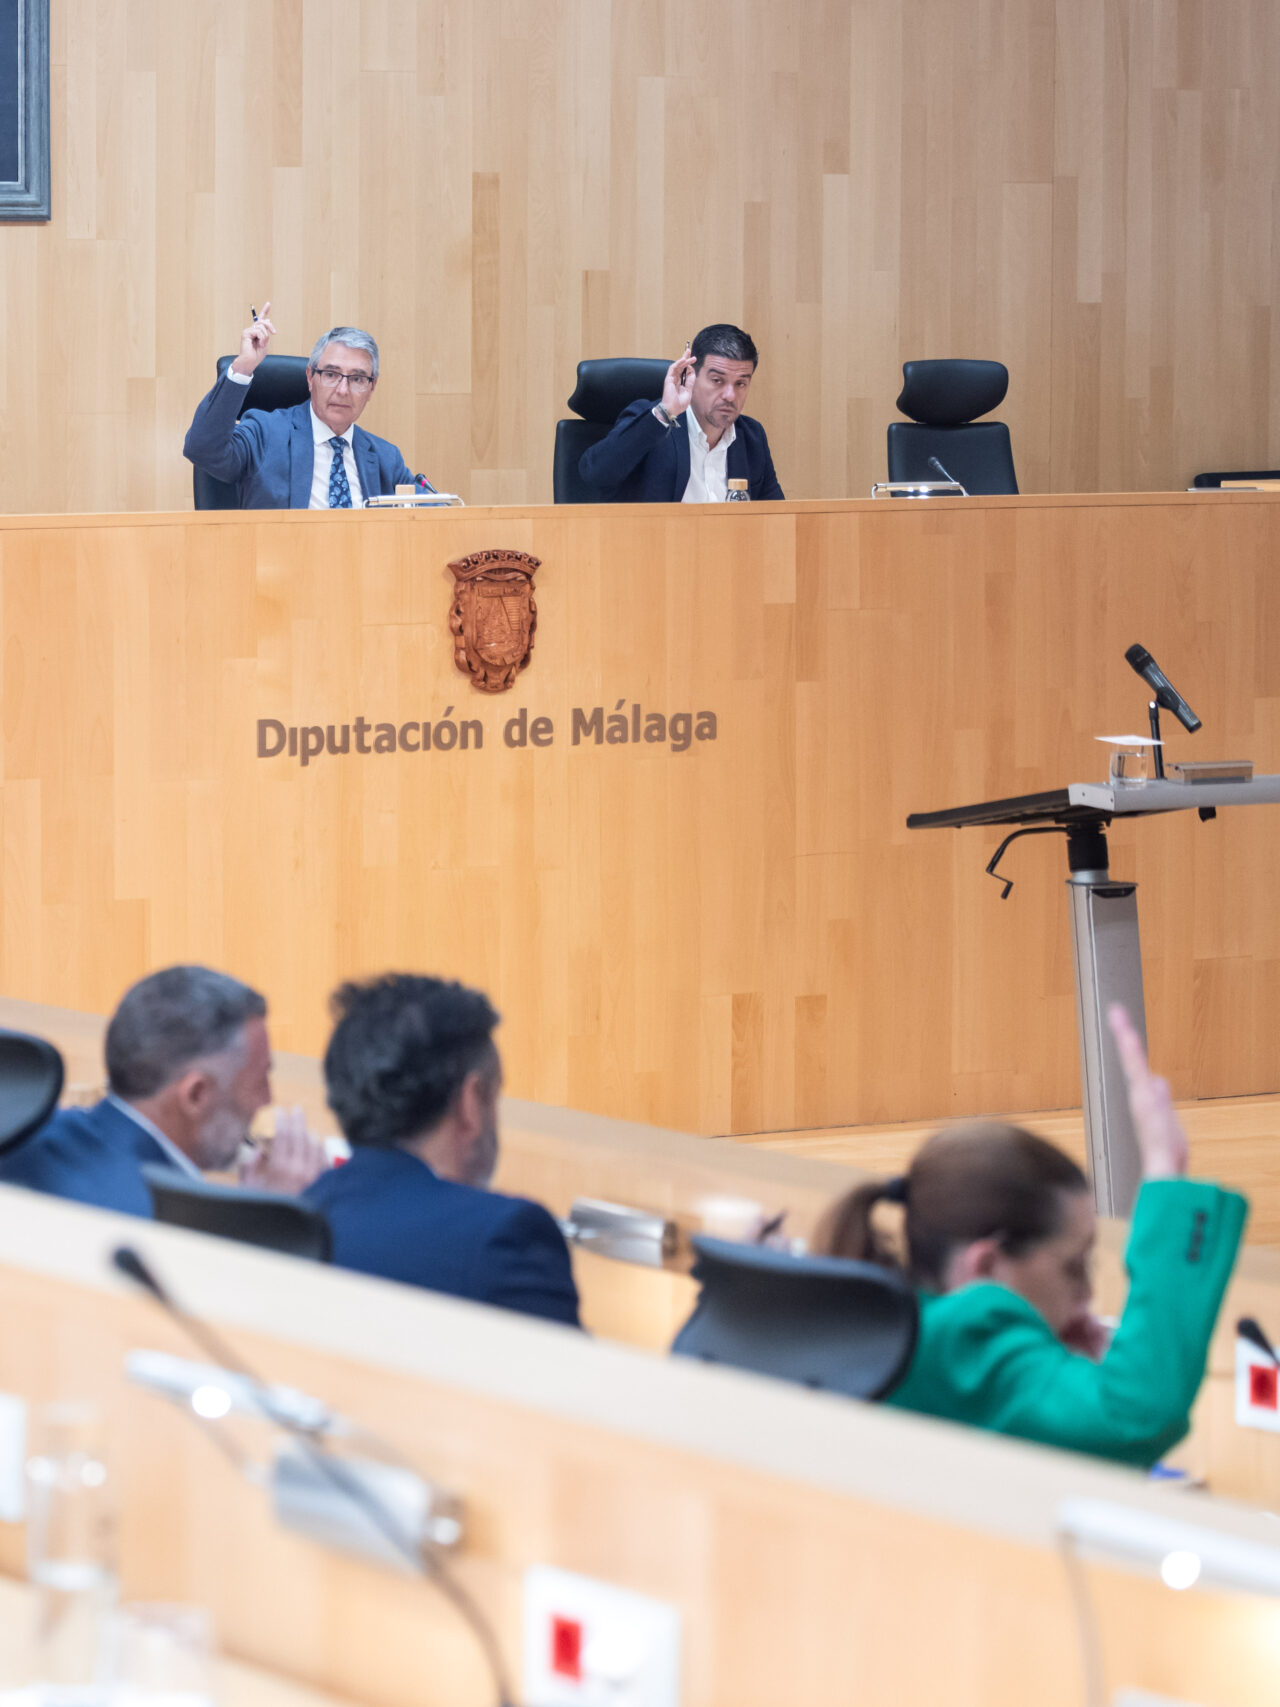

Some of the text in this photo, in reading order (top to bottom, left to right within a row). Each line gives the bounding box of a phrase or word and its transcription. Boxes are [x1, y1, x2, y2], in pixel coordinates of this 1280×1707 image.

[257, 699, 718, 766] Diputación de Málaga
